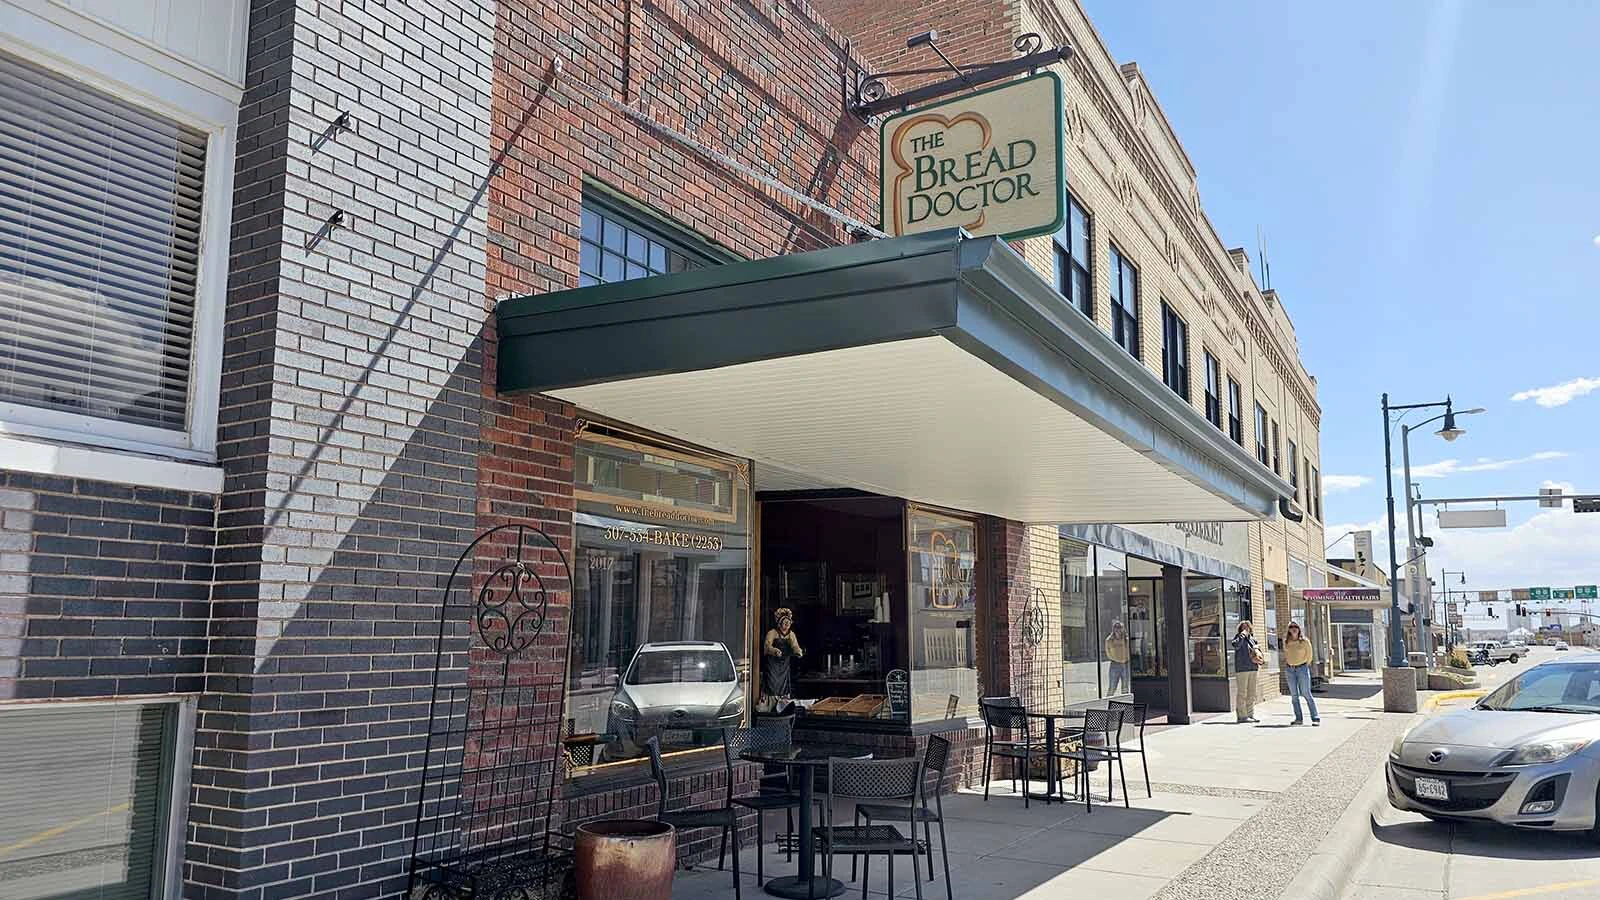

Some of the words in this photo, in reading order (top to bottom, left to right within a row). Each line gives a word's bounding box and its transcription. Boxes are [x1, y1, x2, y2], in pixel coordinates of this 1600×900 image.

[910, 131, 945, 153] THE
[914, 139, 1037, 193] BREAD
[907, 173, 1040, 224] DOCTOR
[590, 556, 614, 570] 2017
